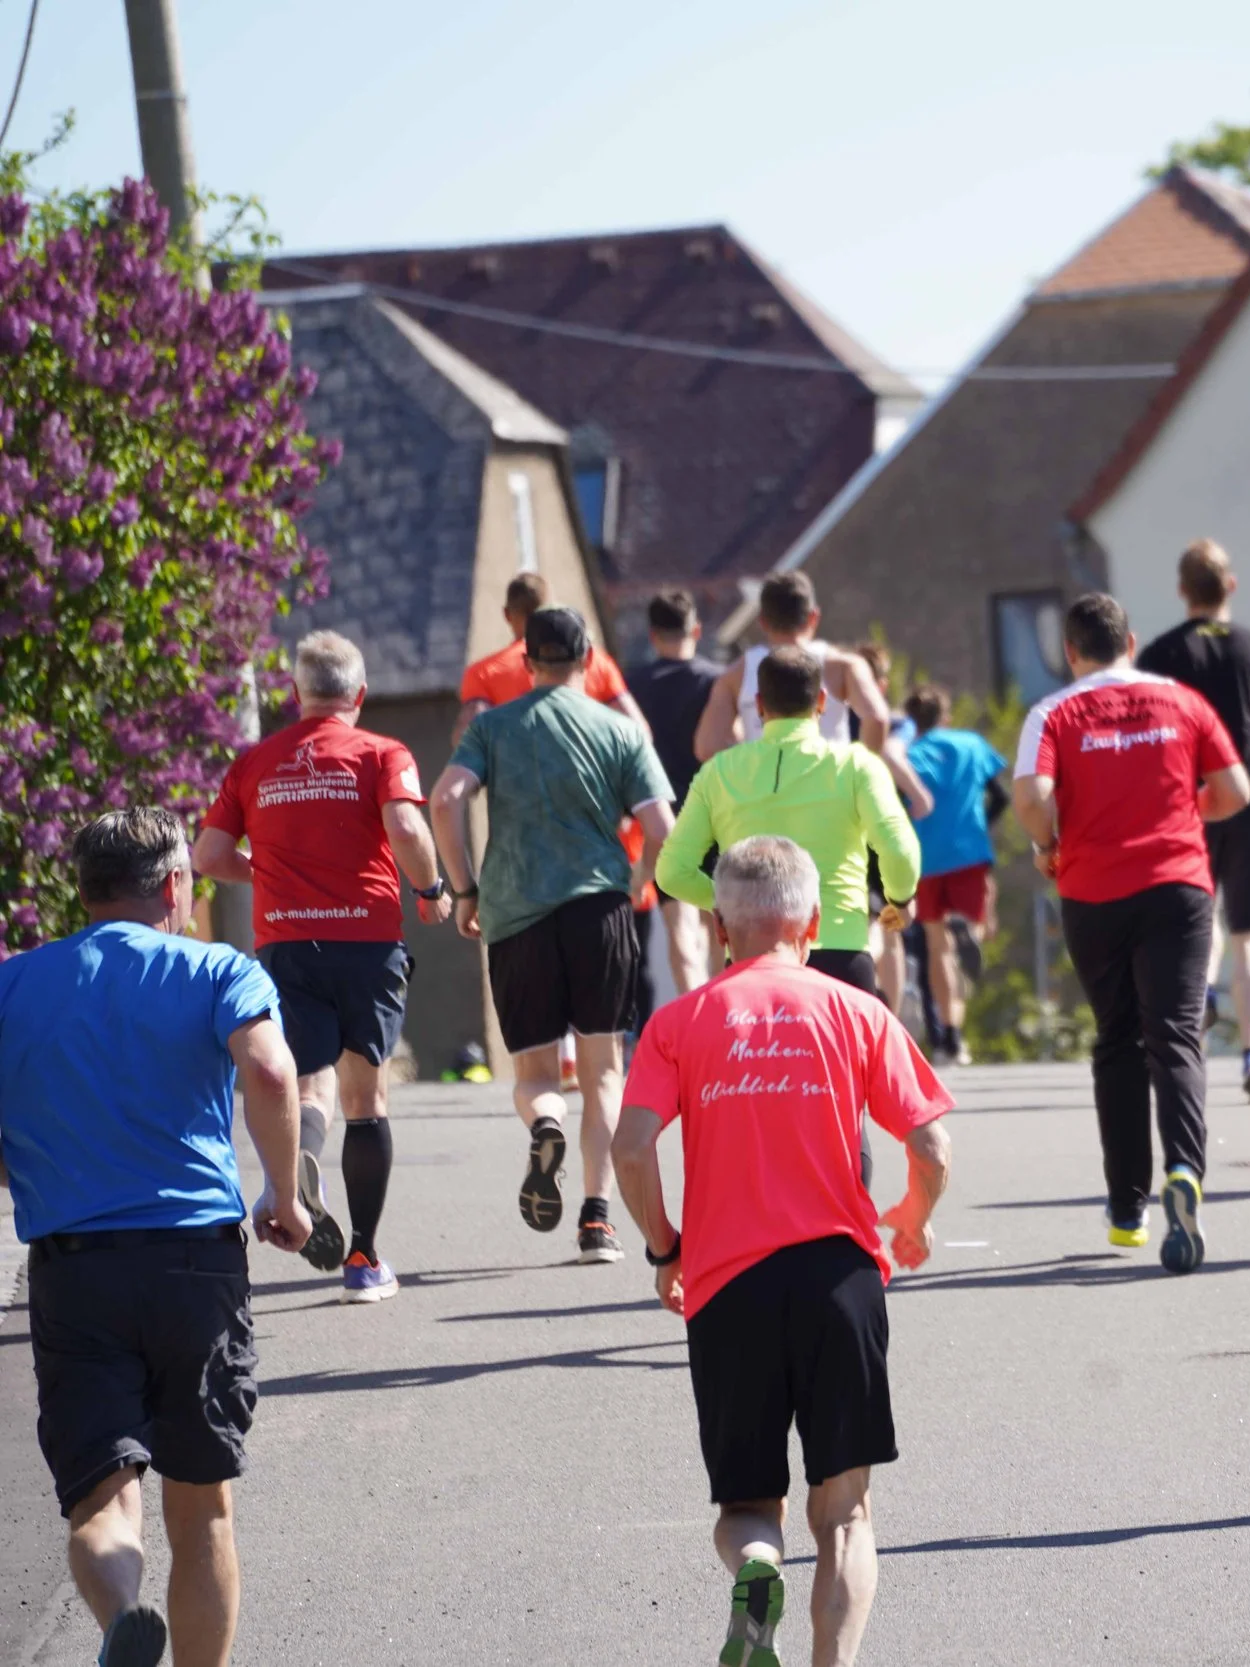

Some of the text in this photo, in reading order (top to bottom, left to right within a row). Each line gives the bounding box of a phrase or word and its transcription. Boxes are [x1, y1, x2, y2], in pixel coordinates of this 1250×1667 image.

[258, 777, 357, 796] Sparkasse Muldental
[264, 906, 369, 924] spk-muldental.de
